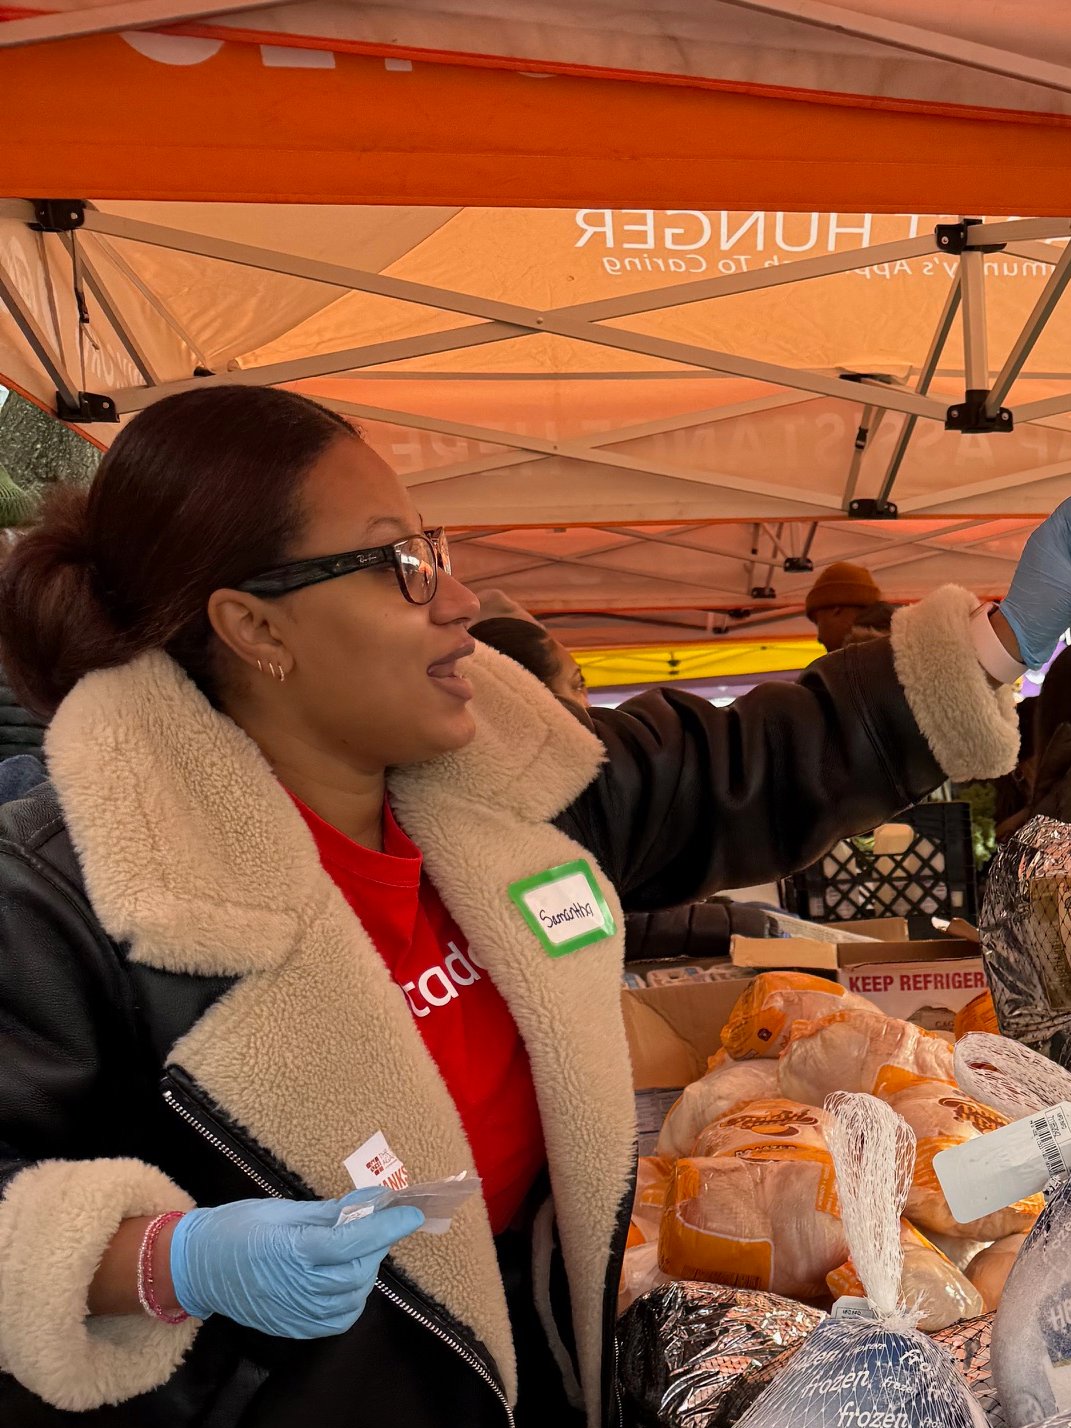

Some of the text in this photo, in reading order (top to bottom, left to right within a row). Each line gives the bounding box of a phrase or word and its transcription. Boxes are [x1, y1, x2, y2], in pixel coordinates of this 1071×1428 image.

[539, 902, 594, 928] Samantha
[849, 971, 988, 993] KEEP REFRIGER
[802, 1370, 870, 1399] frozen
[838, 1402, 910, 1428] frozen
